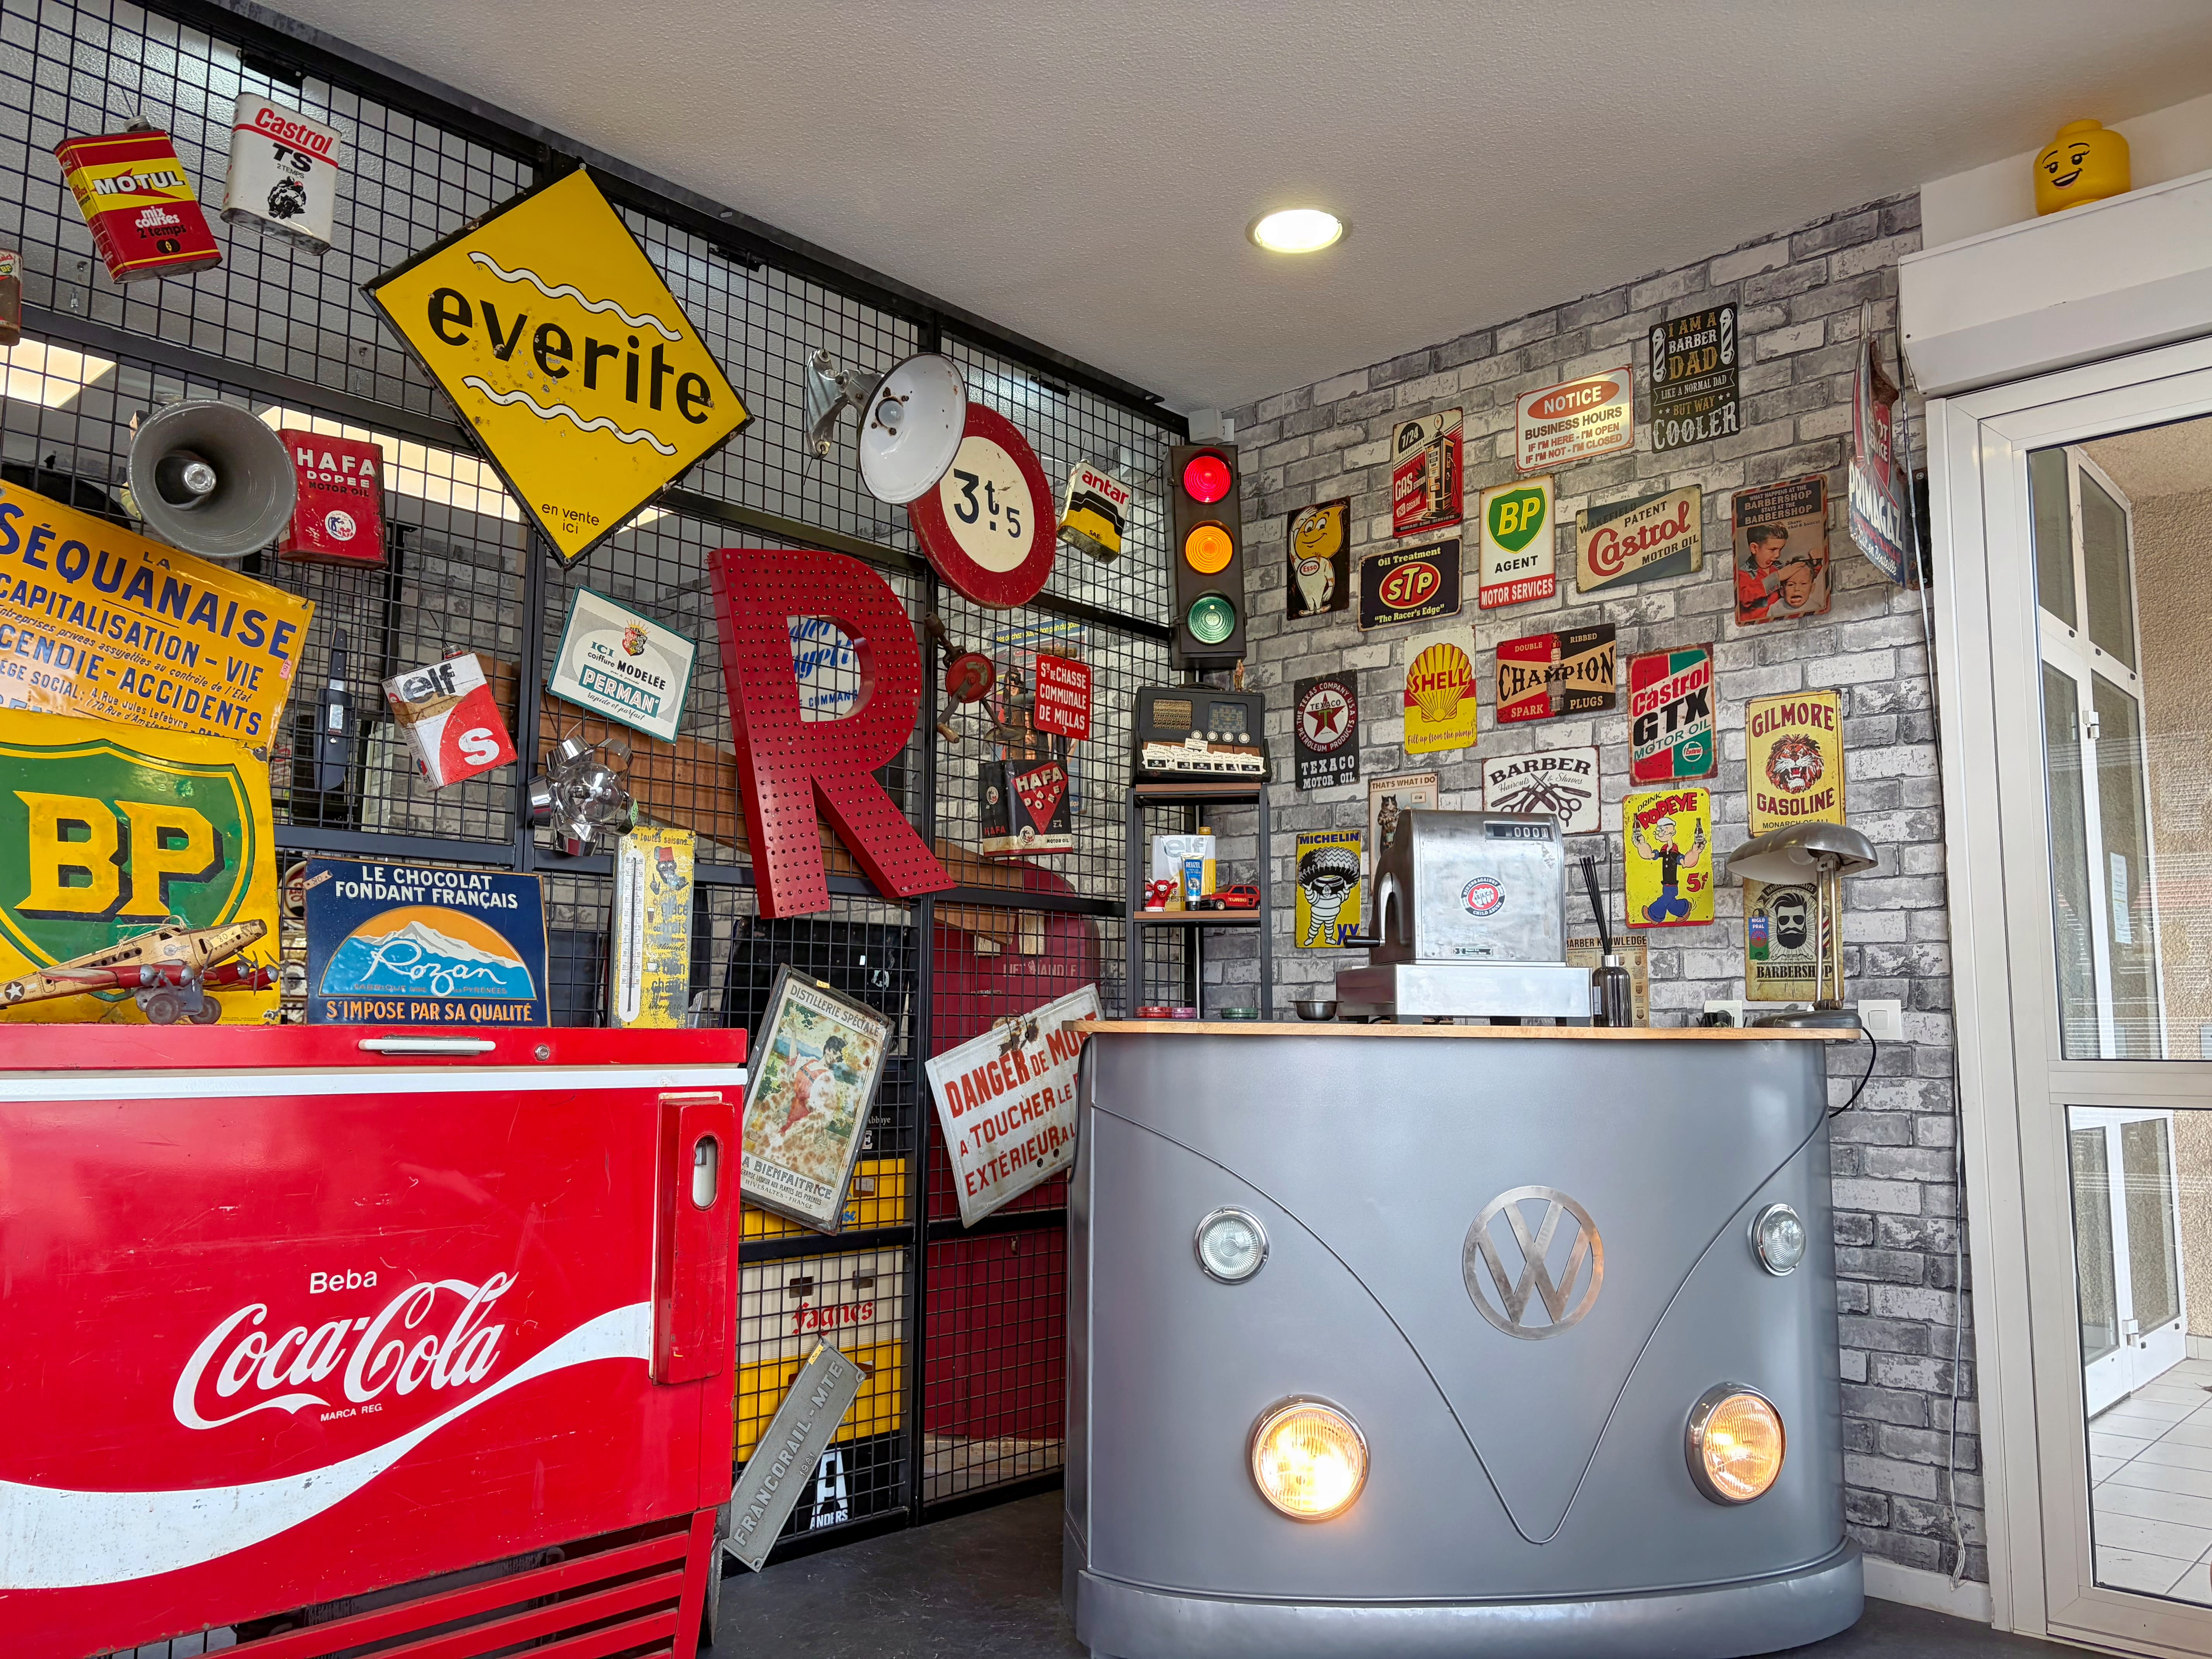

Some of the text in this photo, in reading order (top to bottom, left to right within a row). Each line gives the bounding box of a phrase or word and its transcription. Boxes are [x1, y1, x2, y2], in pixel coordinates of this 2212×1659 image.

[255, 108, 333, 155] Castrol
[273, 143, 312, 172] TS
[92, 171, 185, 195] MOTUL
[282, 165, 304, 179] TEMPS
[136, 215, 180, 228] courses
[141, 206, 165, 218] mix
[137, 224, 186, 239] 2 temps
[1678, 312, 1717, 334] AM A
[1668, 329, 1717, 354] BARBER
[428, 287, 714, 424] everite
[1669, 346, 1718, 381] DAD
[1544, 385, 1602, 415] NOTICE
[1661, 374, 1727, 400] LIKE NORMAL DAD
[1673, 395, 1715, 416] BUT WAY
[1525, 406, 1622, 441] BUSINESS HOURS
[1528, 422, 1620, 452] IF I'M HERE I'M OPEN
[1653, 401, 1739, 450] COOLER
[297, 447, 376, 477] HAFA
[1526, 433, 1622, 464] IF I'M NOT I'M CLOSED
[309, 481, 369, 497] MOTOR OIL
[1082, 470, 1129, 505] antar
[1395, 472, 1413, 501] GAS
[1745, 489, 1812, 511] BARBERSHOP
[1765, 489, 1788, 498] HAPPENS
[542, 502, 600, 526] en vente
[1497, 496, 1540, 536] BP
[1579, 501, 1667, 534] WAKEFIELD PATENT
[1745, 504, 1812, 525] BARBERSHOP
[1849, 460, 1902, 551] PRIMAGAZ
[562, 522, 579, 534] ici
[1089, 530, 1100, 539] SAE
[1588, 500, 1690, 577] Castrol
[144, 551, 170, 570] LA
[1377, 546, 1441, 567] Oil Treatment
[1642, 534, 1699, 565] MOTOR OIL
[1494, 555, 1538, 574] AGENT
[0, 503, 296, 660] SÉQUANAISE
[1387, 566, 1433, 601] STP
[1481, 578, 1553, 606] MOTOR SERVICES
[0, 573, 264, 692] CAPITALISATION VIE
[1514, 632, 1597, 653] DOUBLE RIBBED
[57, 629, 222, 692] privées assujetties au contrôle de
[590, 641, 615, 658] ICI
[402, 663, 455, 704] elf
[587, 652, 666, 690] coiffure MODELÉE
[1056, 667, 1087, 689] CHASSE
[1412, 668, 1468, 694] SHELL
[1498, 644, 1615, 702] CHAMPION
[1040, 683, 1087, 711] COMMUNALE
[1300, 682, 1350, 708] TEXAS COMPANY
[1633, 661, 1709, 717] Castrol
[122, 700, 146, 715] Jules
[588, 692, 646, 721] rapide parfait
[1039, 704, 1085, 731] DE MILLAS
[1310, 699, 1341, 710] TEXACO
[1511, 696, 1603, 718] SPARK PLUGS
[1633, 685, 1710, 747] GTX
[1752, 702, 1834, 737] GILMORE
[458, 728, 500, 766] S
[708, 548, 957, 919] R
[1298, 727, 1327, 752] PETROLEUM
[1330, 720, 1355, 750] PRODUCTS
[1408, 728, 1474, 745] Fill from the pump!
[1634, 720, 1711, 760] MOTOR OIL
[1302, 755, 1355, 775] TEXACO
[1685, 747, 1703, 756] Castrol
[1015, 767, 1063, 793] HAFA
[1302, 771, 1355, 790] MOTOR OIL
[1372, 780, 1395, 790] THAT'S
[1397, 778, 1419, 787] WHAT
[1488, 758, 1591, 786] BARBER
[1498, 772, 1583, 793] Haircuts Shaves
[1638, 791, 1662, 812] DRINK
[1638, 792, 1698, 830] POPEYE
[1757, 787, 1835, 816] GASOLINE
[984, 826, 1006, 836] HAFA
[1300, 833, 1360, 845] MICHELIN
[13, 790, 225, 924] BP
[1164, 837, 1204, 858] elf
[311, 876, 323, 885] 80
[362, 865, 493, 891] LE CHOCOLAT
[1477, 877, 1498, 886] AGAINST
[335, 881, 519, 910] FONDANT FRANÇAIS
[217, 933, 228, 942] 80
[360, 941, 507, 997] Rozan
[410, 1003, 532, 1023] PAR SA QUALITÉ
[790, 984, 880, 1037] DISTILLERIE SPÉCIALE
[944, 1049, 1030, 1118] DANGER
[1030, 1050, 1049, 1077] DE
[960, 1083, 1073, 1157] A TOUCHER LE
[740, 1169, 794, 1195] GRANDE LIQUEUR PLANTES
[754, 1160, 833, 1200] BIENFAITRICE
[745, 1179, 813, 1209] RIVESALTES FRANCE
[310, 1269, 378, 1295] Beba
[792, 1301, 874, 1337] Fagnes
[173, 1271, 520, 1431] Coca-Cola
[320, 1408, 357, 1422] MARCA
[733, 1360, 843, 1547] FRANCORAIL MTE
[809, 1508, 848, 1530] ANDERS
